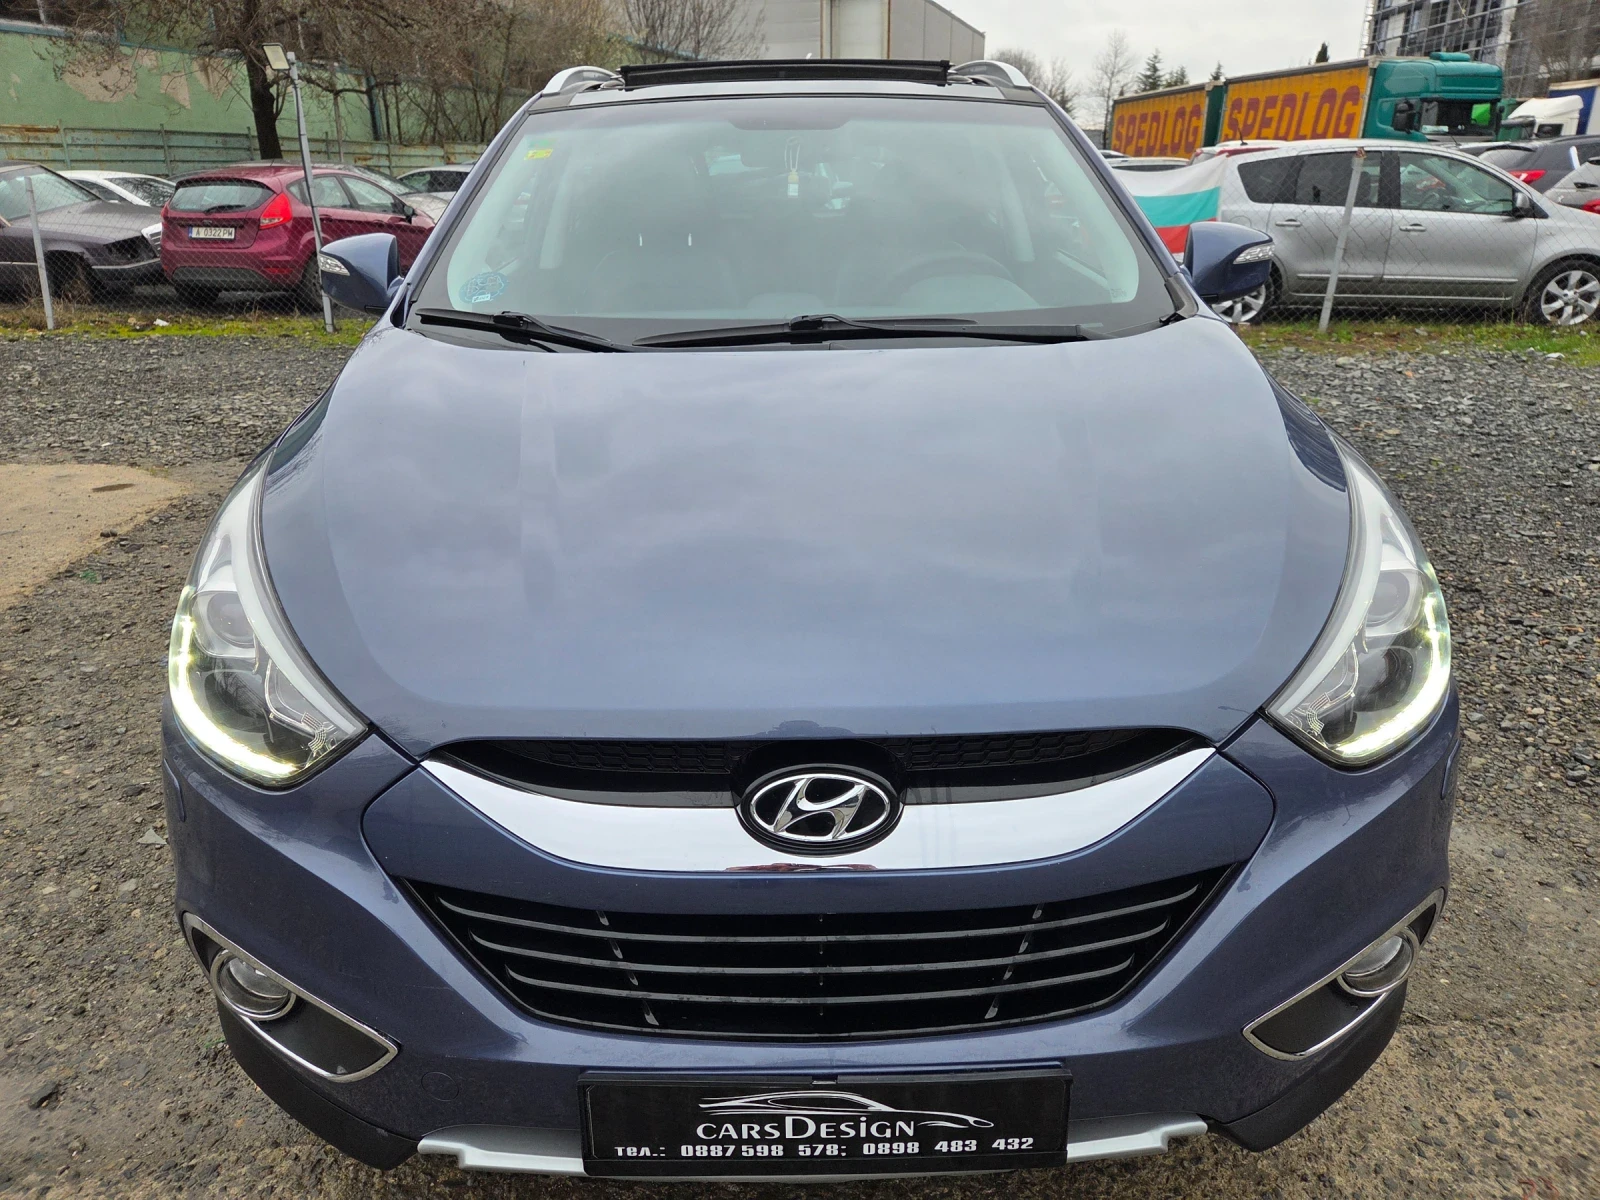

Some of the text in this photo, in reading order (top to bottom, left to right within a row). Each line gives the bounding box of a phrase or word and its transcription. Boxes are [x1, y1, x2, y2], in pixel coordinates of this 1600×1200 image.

[1114, 104, 1201, 157] SPEDLOG
[1225, 85, 1360, 141] SPEDLOG
[203, 228, 222, 237] 0322
[680, 1144, 737, 1158] 0887
[741, 1144, 785, 1157] 598
[862, 1141, 920, 1156] 0898
[934, 1139, 978, 1153] 483
[991, 1137, 1035, 1150] 432
